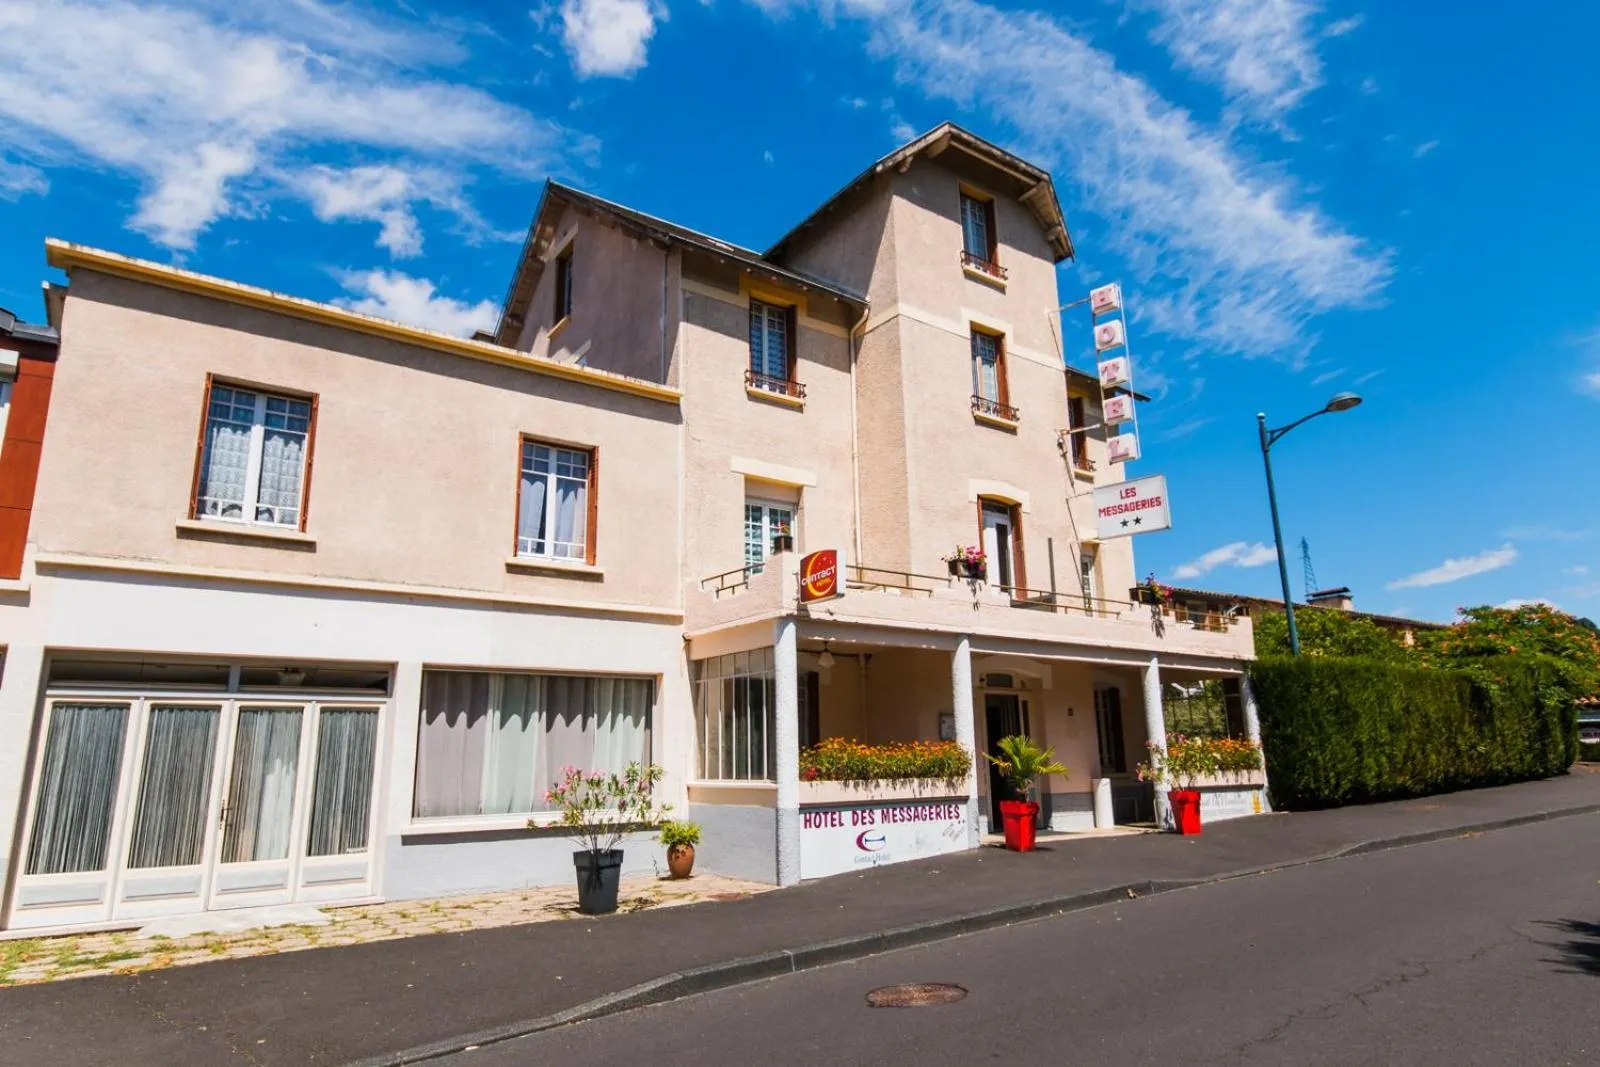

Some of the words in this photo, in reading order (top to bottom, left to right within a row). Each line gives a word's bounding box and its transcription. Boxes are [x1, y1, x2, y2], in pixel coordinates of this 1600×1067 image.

[1120, 487, 1137, 500] LES
[1098, 496, 1162, 518] MESSAGERIES
[803, 810, 845, 829] HOTEL
[851, 809, 876, 827] DES
[881, 804, 960, 825] MESSAGERIES
